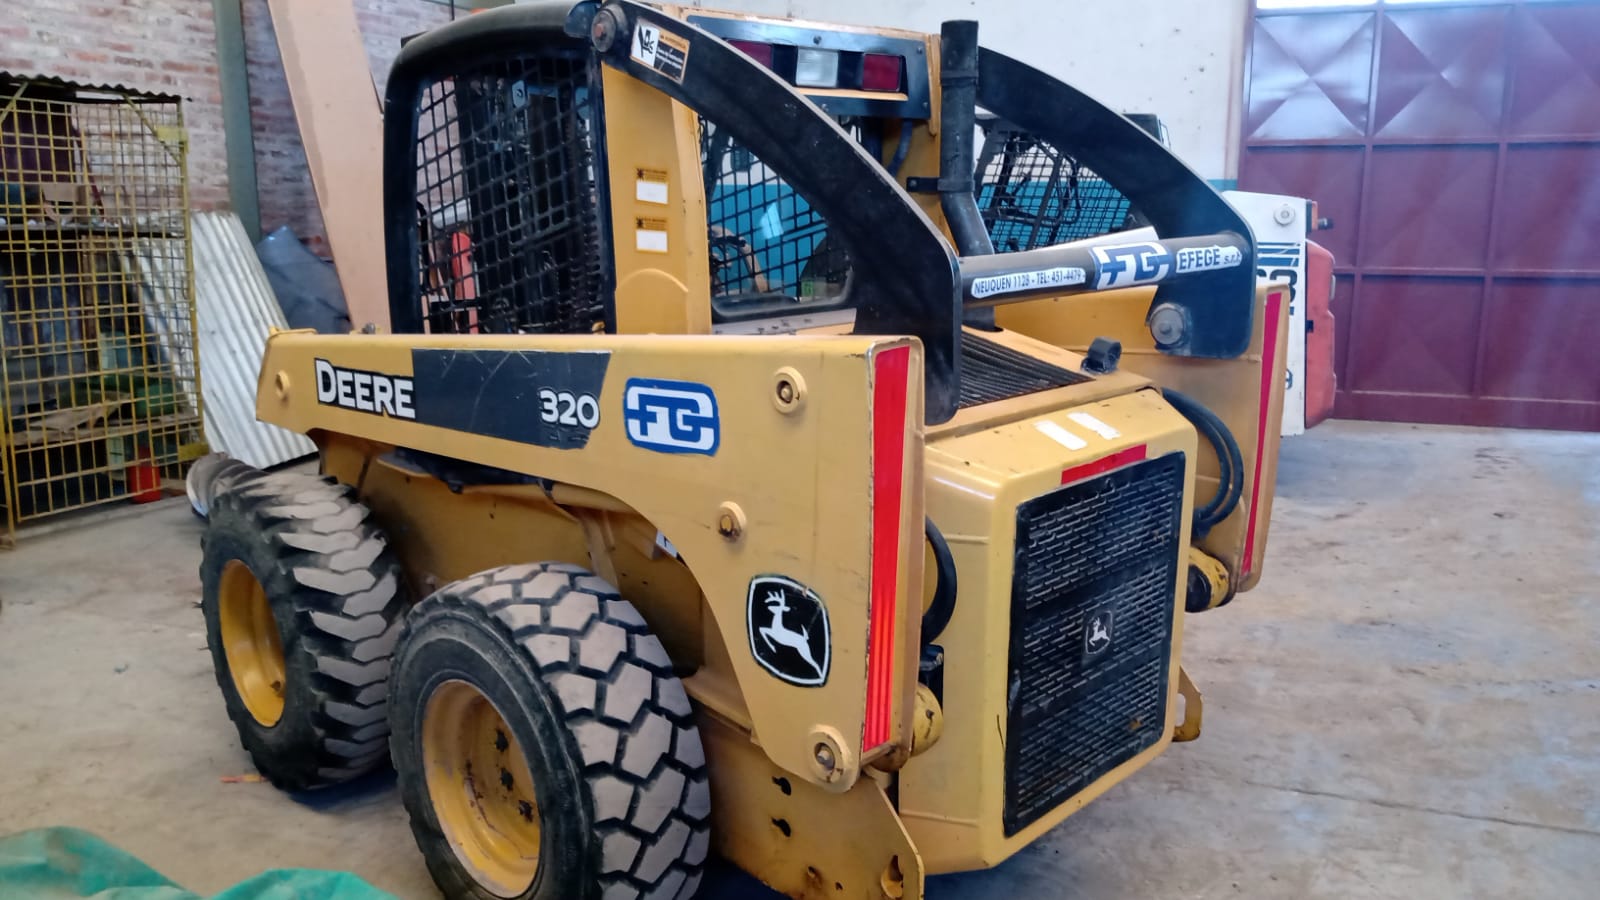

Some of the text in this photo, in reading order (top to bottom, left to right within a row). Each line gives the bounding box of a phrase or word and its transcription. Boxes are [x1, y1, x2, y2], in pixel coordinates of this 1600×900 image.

[1178, 248, 1221, 270] EFEGE
[973, 275, 1012, 294] NEUQUEN
[314, 358, 417, 419] DEERE
[539, 389, 600, 429] 320
